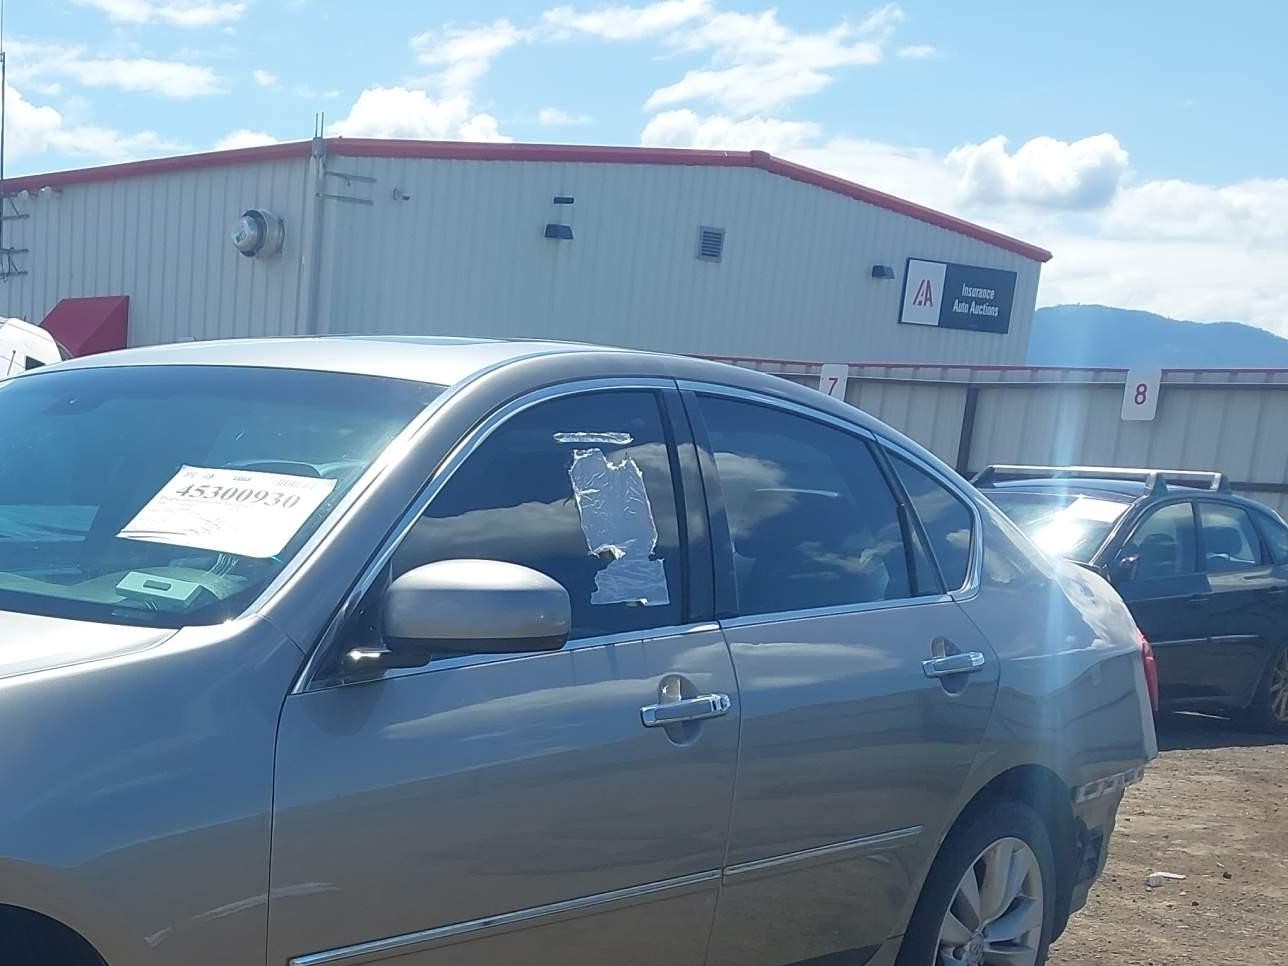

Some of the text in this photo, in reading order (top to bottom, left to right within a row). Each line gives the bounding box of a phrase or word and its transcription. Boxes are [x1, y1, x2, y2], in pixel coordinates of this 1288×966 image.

[961, 283, 995, 299] Insurance
[953, 299, 999, 317] Auto Auctions
[828, 377, 838, 396] 7
[1134, 383, 1148, 405] 8
[175, 483, 301, 509] 45300930
